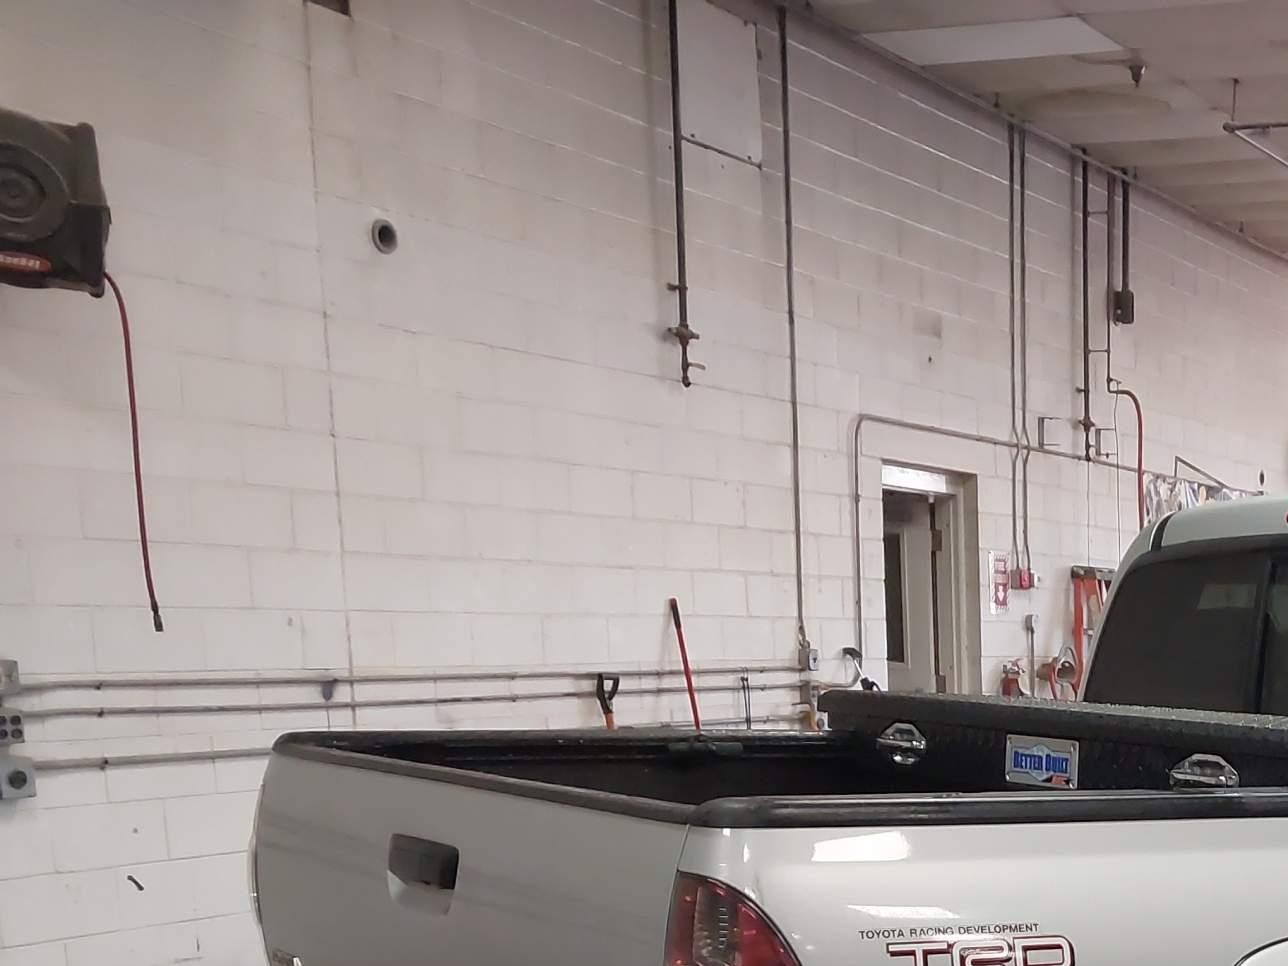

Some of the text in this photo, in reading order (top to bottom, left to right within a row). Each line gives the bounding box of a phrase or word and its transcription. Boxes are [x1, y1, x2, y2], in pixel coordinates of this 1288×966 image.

[859, 923, 1040, 940] TOYOTA RACING DEVELOPMENT
